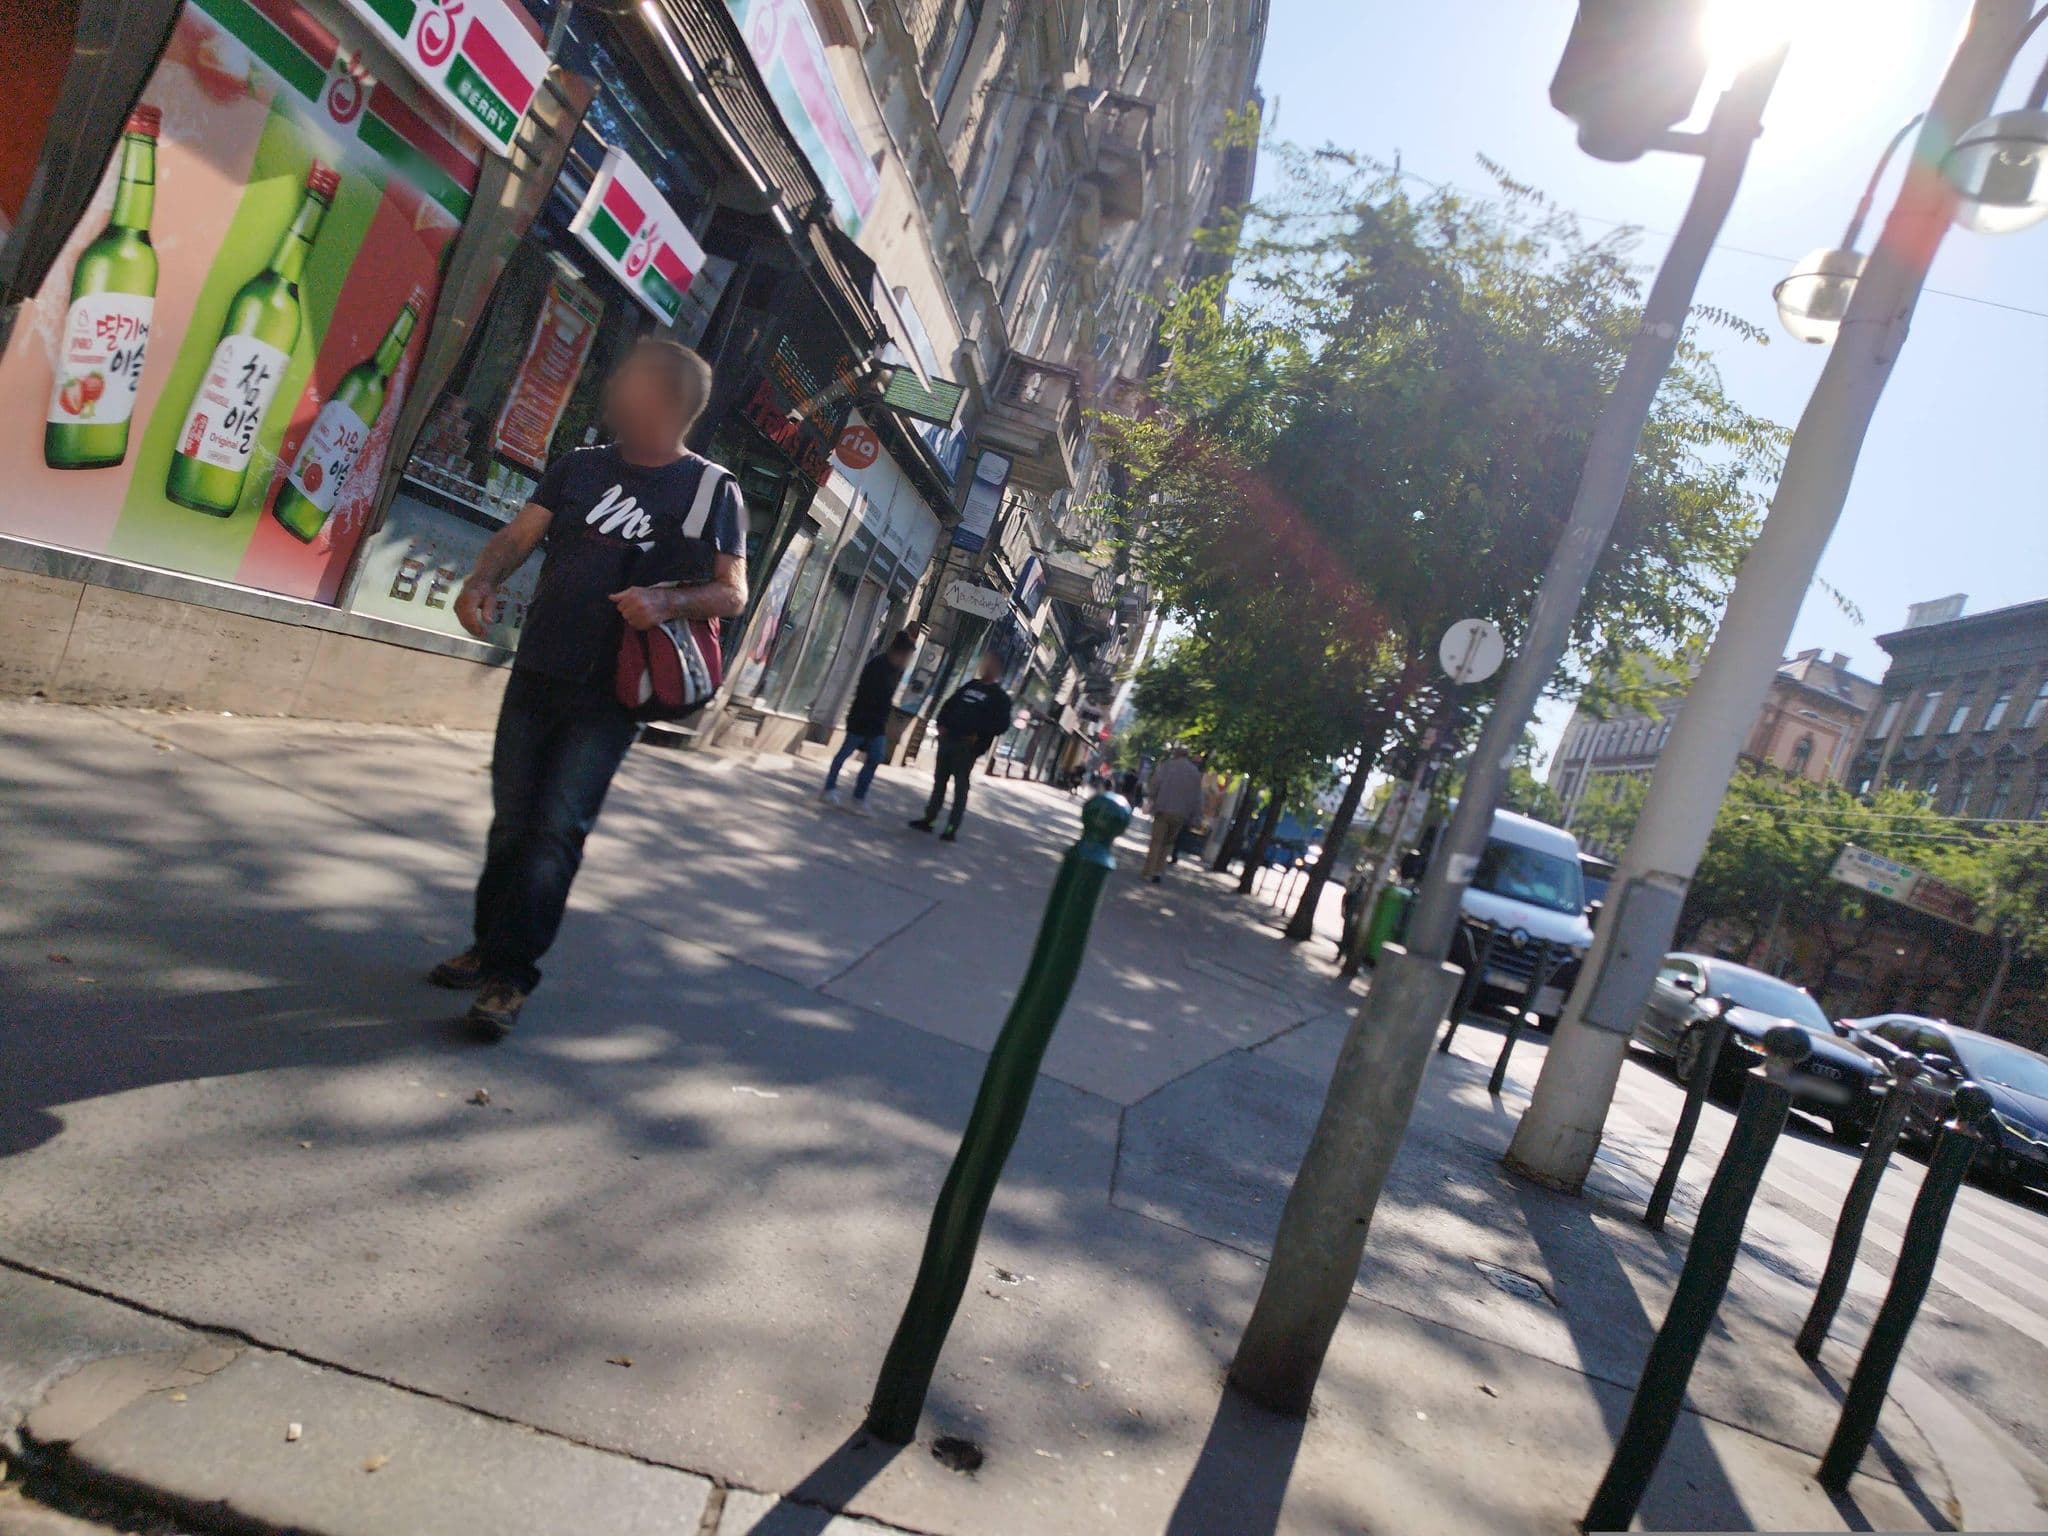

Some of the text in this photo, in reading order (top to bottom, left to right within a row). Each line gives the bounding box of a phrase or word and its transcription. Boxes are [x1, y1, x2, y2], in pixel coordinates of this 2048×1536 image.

[237, 354, 271, 407] 참
[209, 432, 241, 450] Original
[223, 406, 260, 455] 이슬
[841, 431, 875, 458] ria
